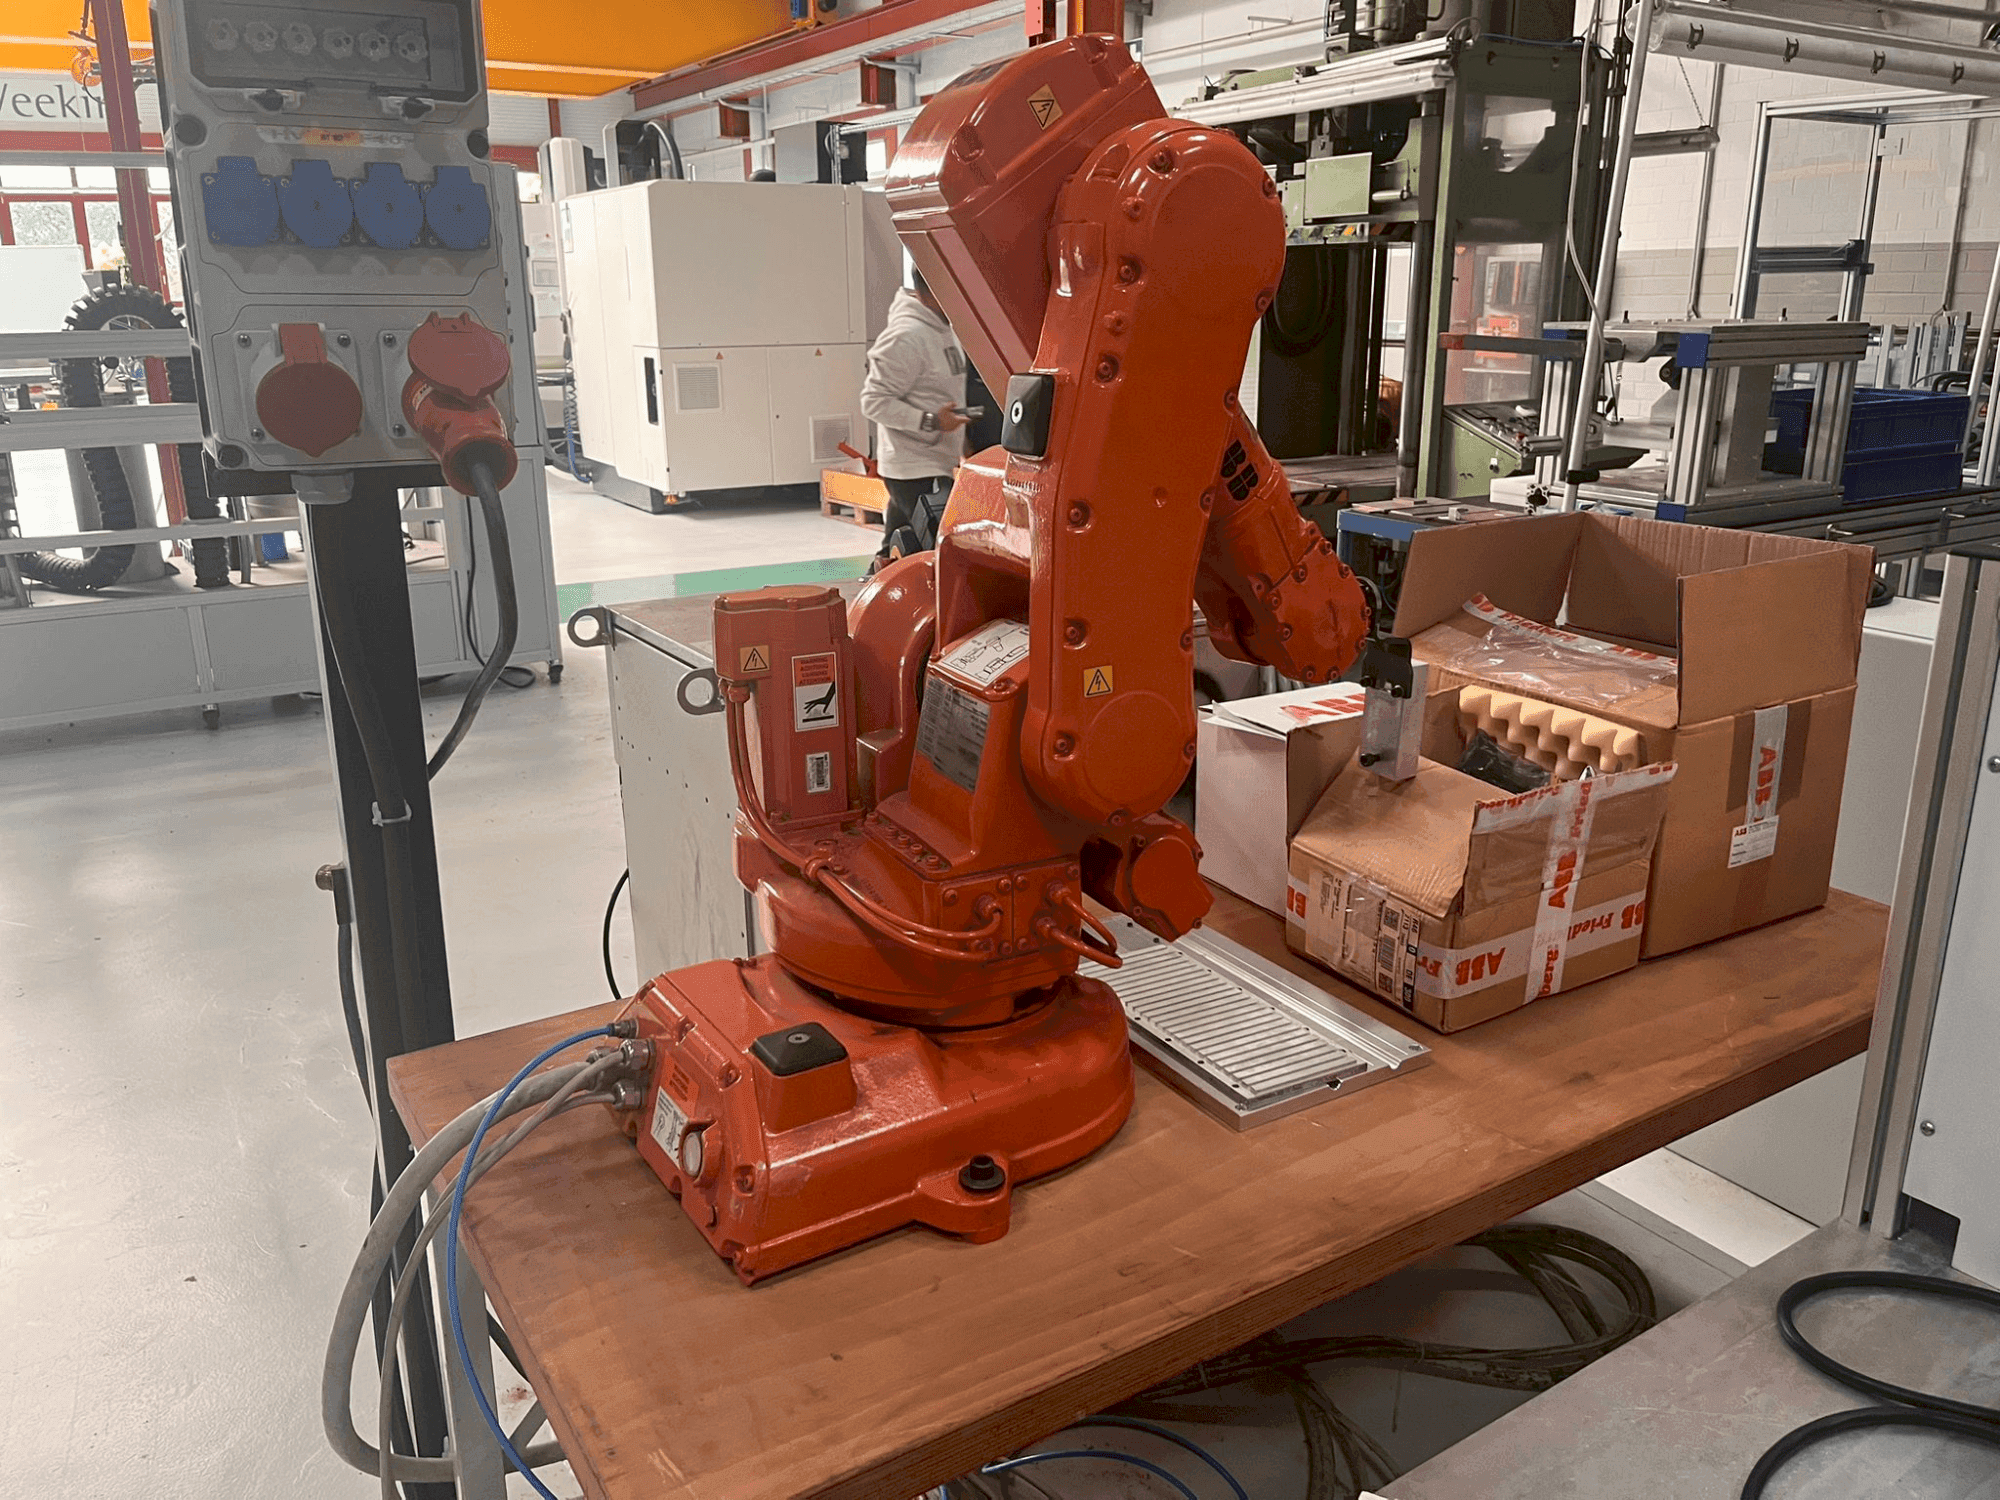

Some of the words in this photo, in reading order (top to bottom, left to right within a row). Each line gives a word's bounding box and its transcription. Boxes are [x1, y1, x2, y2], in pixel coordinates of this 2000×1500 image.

[1755, 746, 1777, 806] ABB
[1548, 850, 1578, 909] ABB
[1567, 912, 1615, 942] Fried
[1455, 947, 1506, 987] ABB
